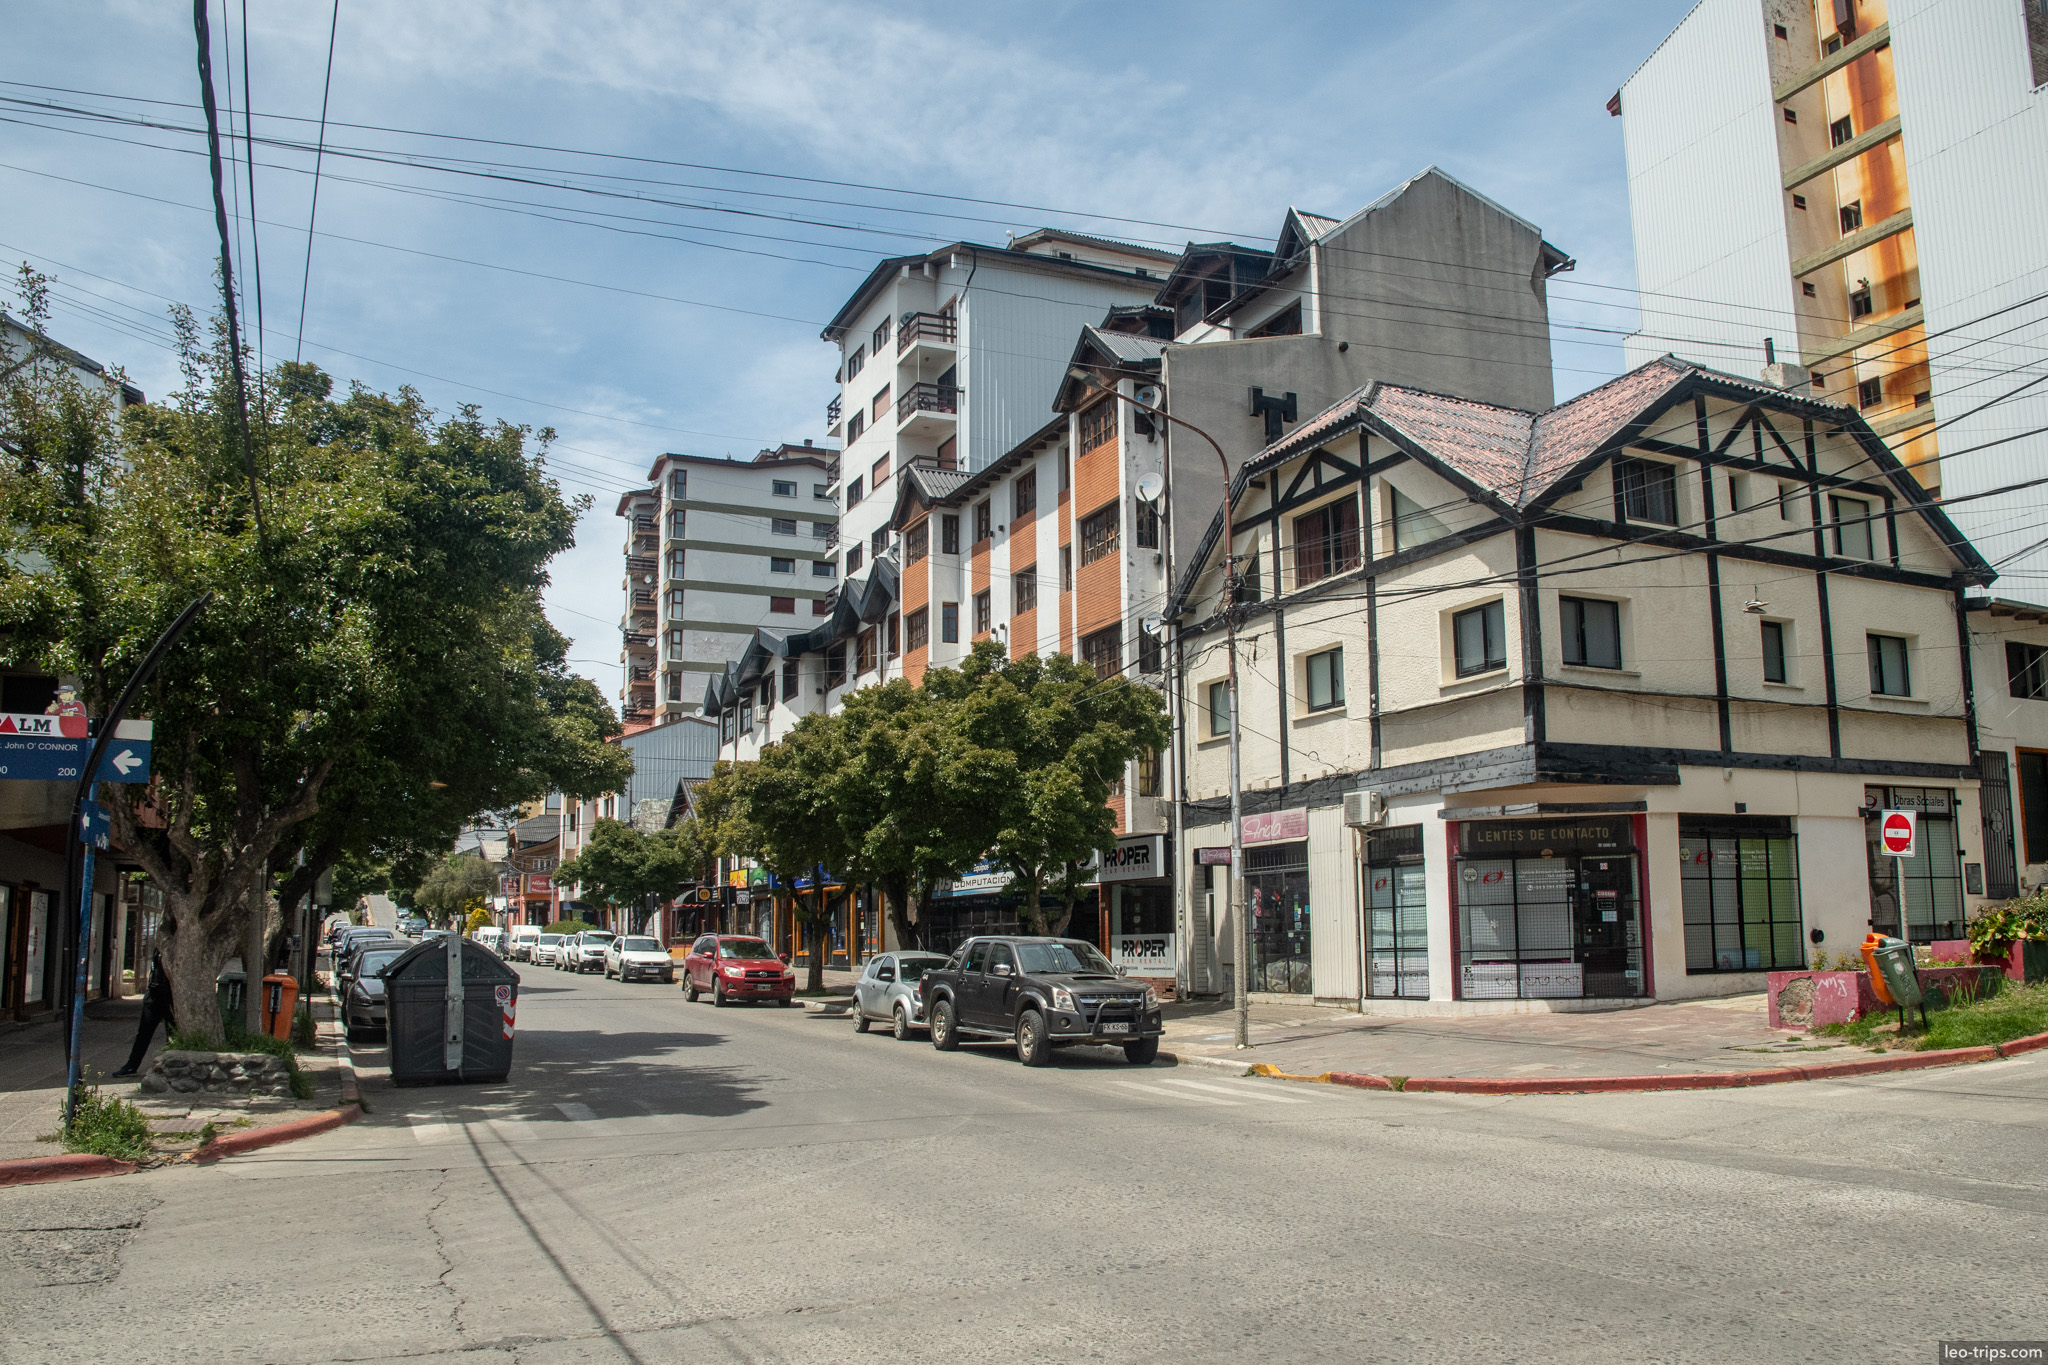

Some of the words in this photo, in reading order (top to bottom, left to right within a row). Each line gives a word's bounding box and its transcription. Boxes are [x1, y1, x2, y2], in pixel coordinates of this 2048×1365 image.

[5, 742, 24, 750] John
[38, 743, 78, 751] CONNOR
[58, 768, 76, 776] 200
[1894, 794, 1914, 806] Obras
[1916, 795, 1944, 807] Sociales
[1244, 819, 1281, 839] Frida
[1477, 830, 1524, 843] LENTES
[1530, 829, 1545, 840] DE
[1551, 827, 1609, 840] CONTACTO
[1104, 845, 1150, 868] PROPER
[1122, 940, 1165, 957] PROPER
